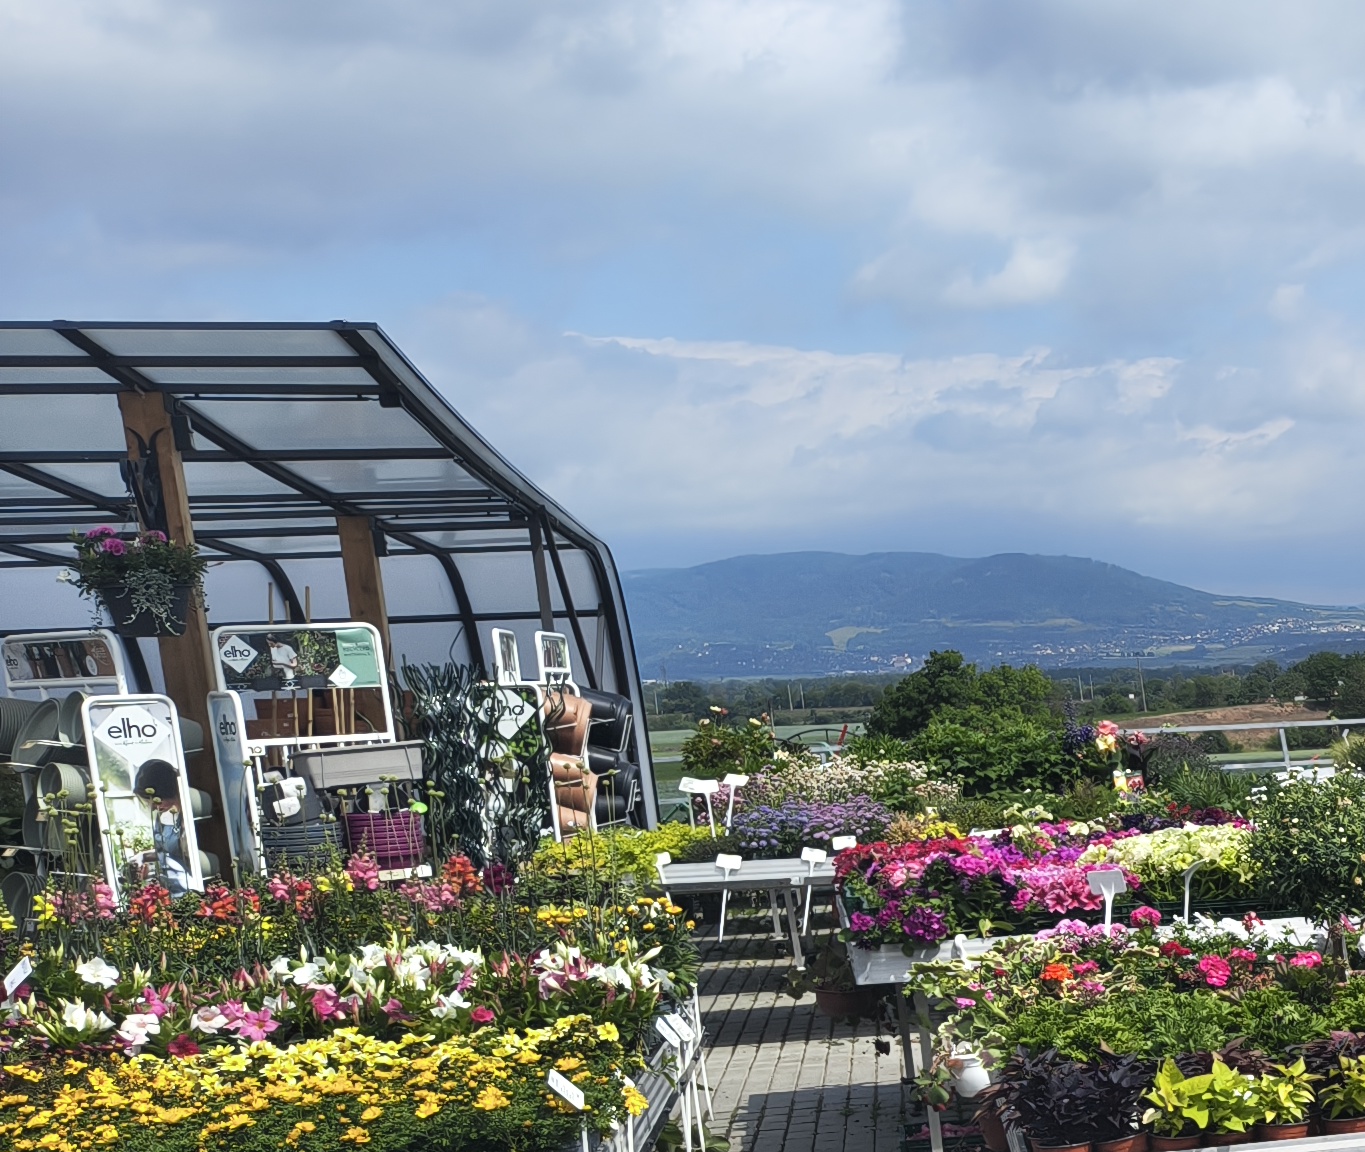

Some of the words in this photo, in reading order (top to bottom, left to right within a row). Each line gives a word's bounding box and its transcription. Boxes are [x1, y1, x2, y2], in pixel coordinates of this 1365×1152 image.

[223, 646, 251, 658] elho
[107, 717, 157, 739] elho
[219, 714, 237, 735] elho
